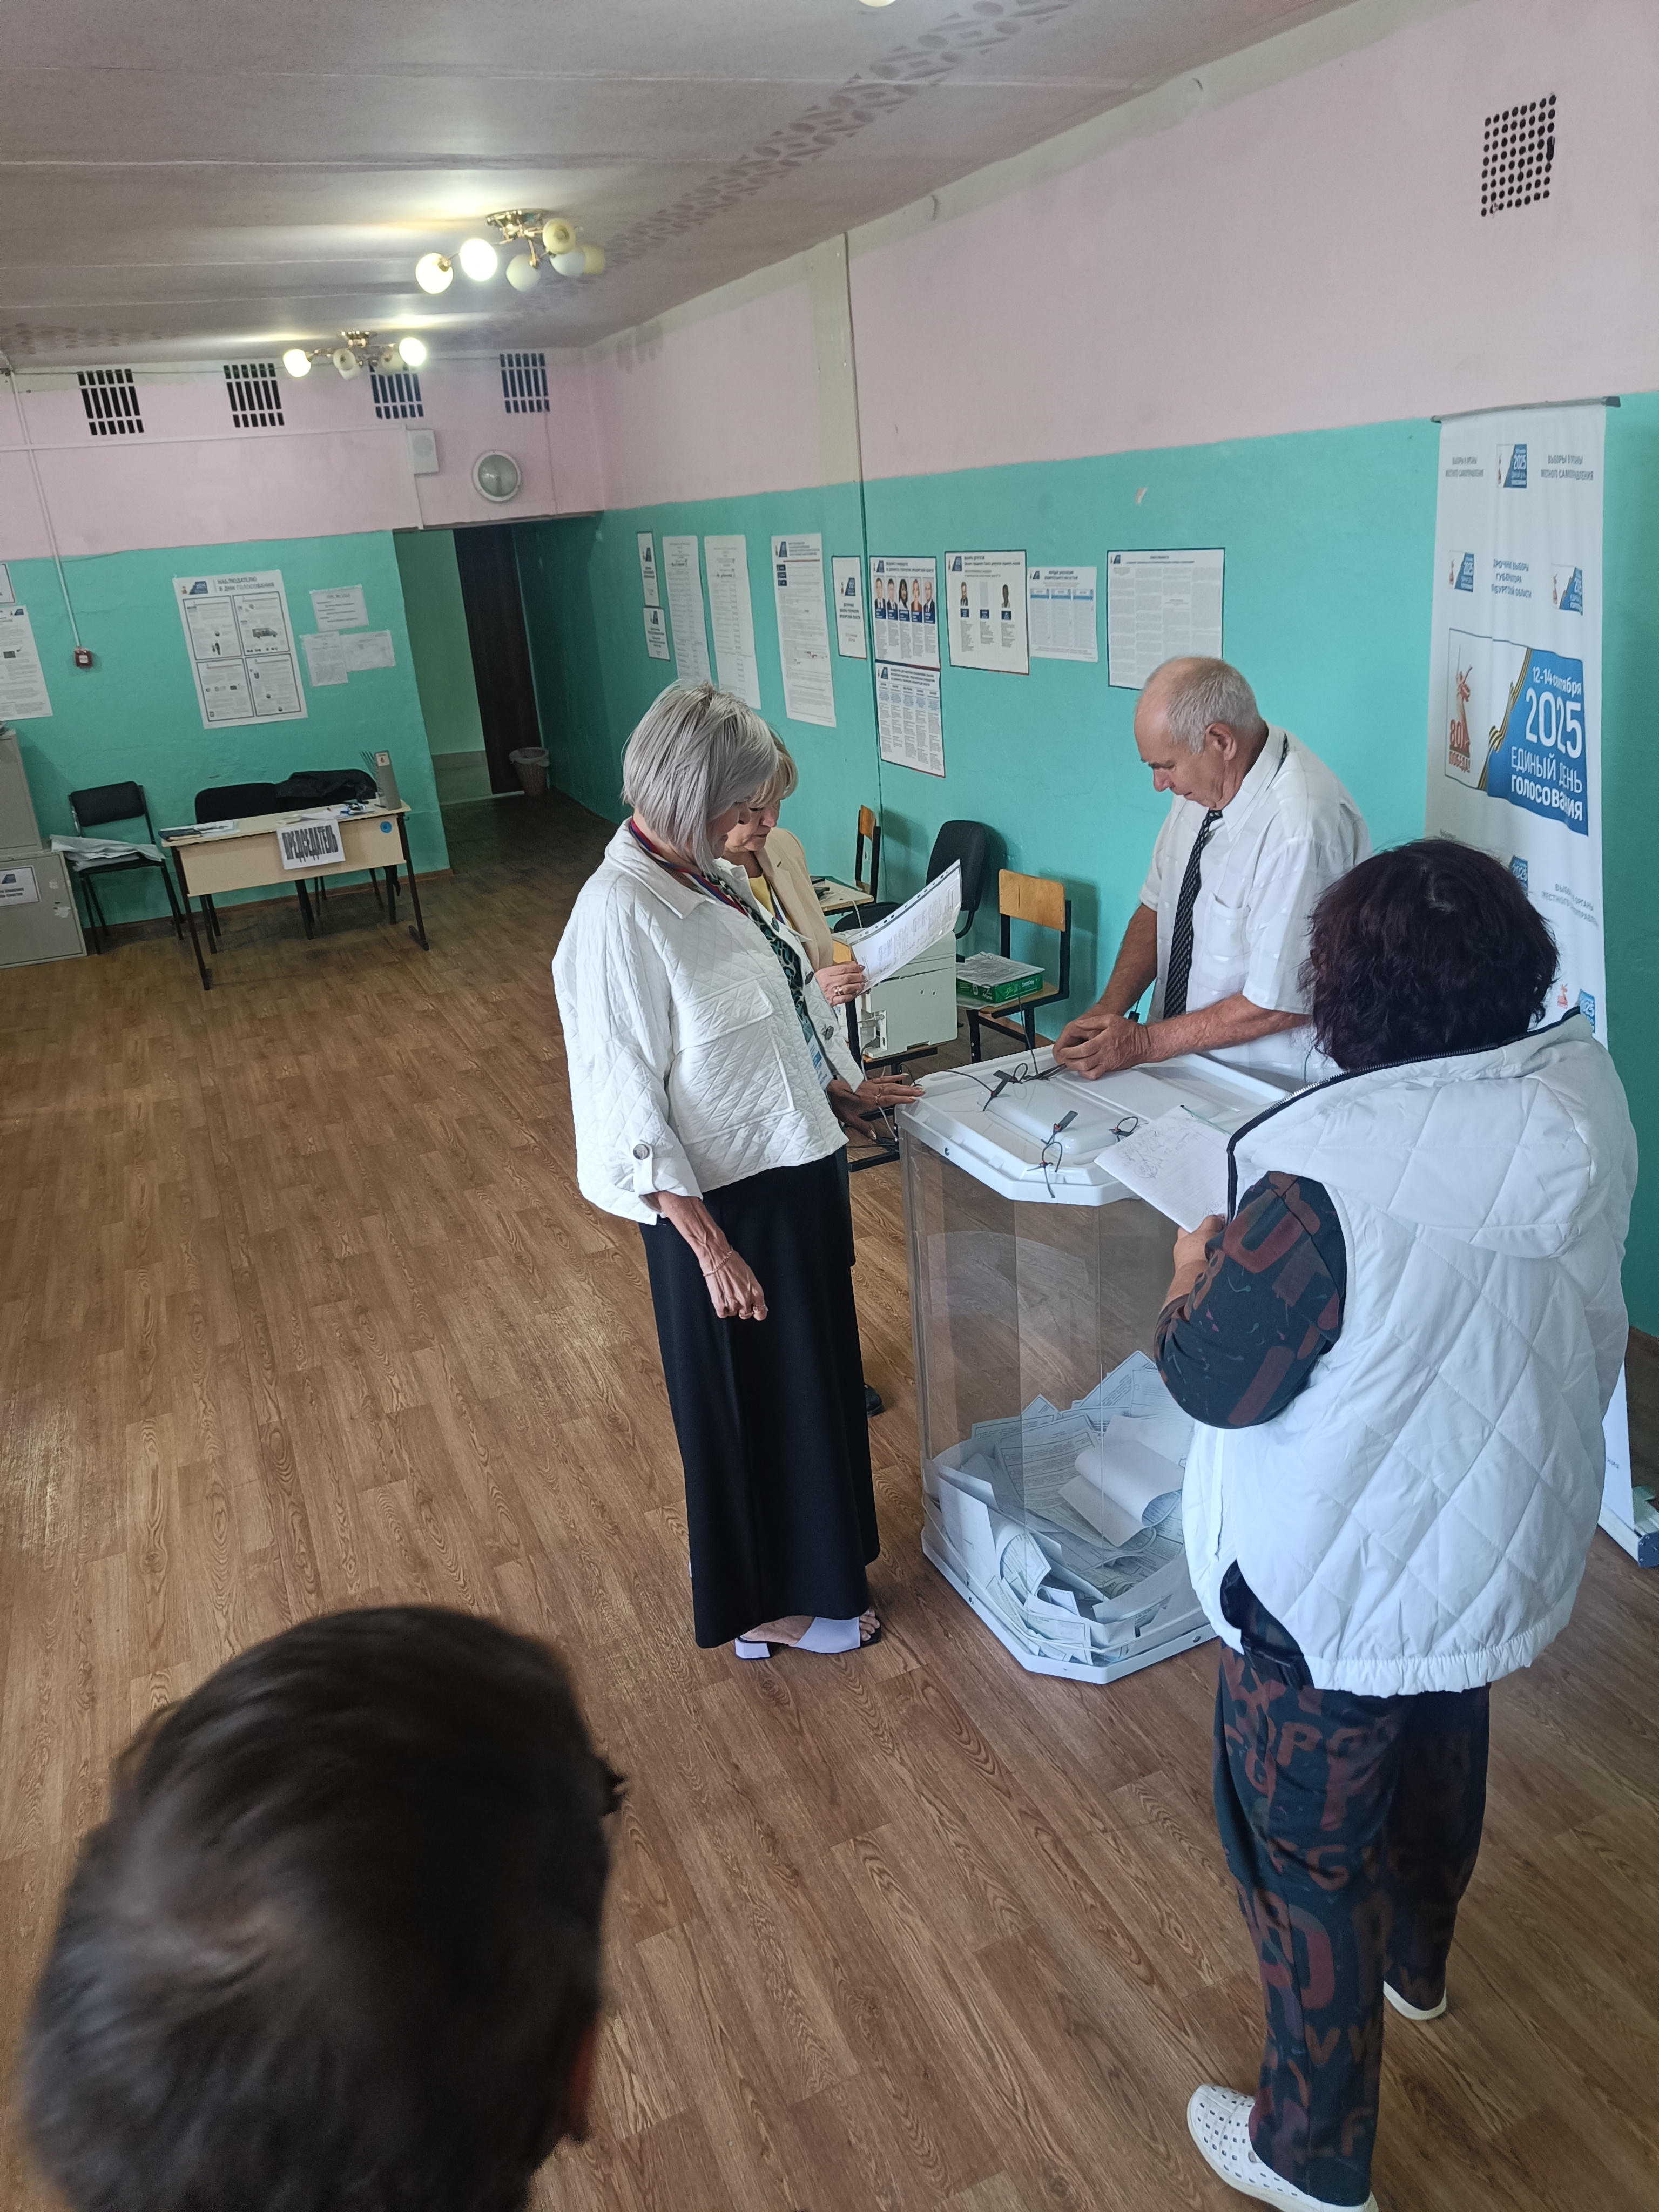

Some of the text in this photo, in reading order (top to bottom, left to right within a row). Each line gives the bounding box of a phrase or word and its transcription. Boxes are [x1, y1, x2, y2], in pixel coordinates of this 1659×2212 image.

[1532, 666, 1553, 685] 12-14
[1525, 687, 1582, 759] 2025
[1511, 746, 1583, 793] ЕДИНЫЙ ДЕНЬ
[281, 825, 339, 863] ПРЕДСЕДАТЕЛЬ
